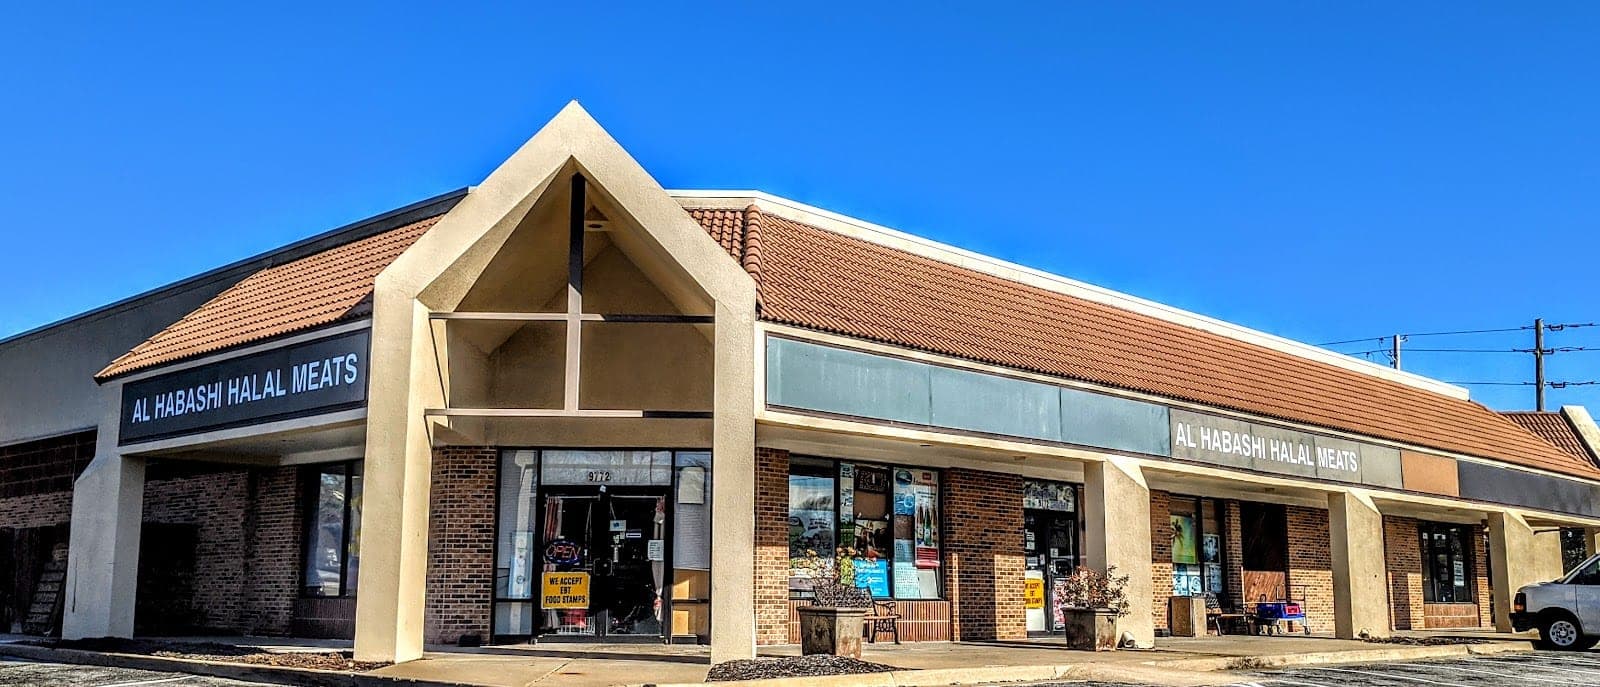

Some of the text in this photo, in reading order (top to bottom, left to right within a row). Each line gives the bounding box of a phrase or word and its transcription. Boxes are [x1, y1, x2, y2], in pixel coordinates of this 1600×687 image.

[131, 353, 358, 423] AL HABASHI HALAL MEATS
[1176, 422, 1358, 473] AL HABASHI HALAL MEATS
[588, 471, 610, 482] 9772
[546, 544, 581, 560] OPEN
[549, 577, 583, 585] WE ACCEPT
[560, 586, 571, 595] EBT
[545, 595, 586, 604] FOOD STAMPS
